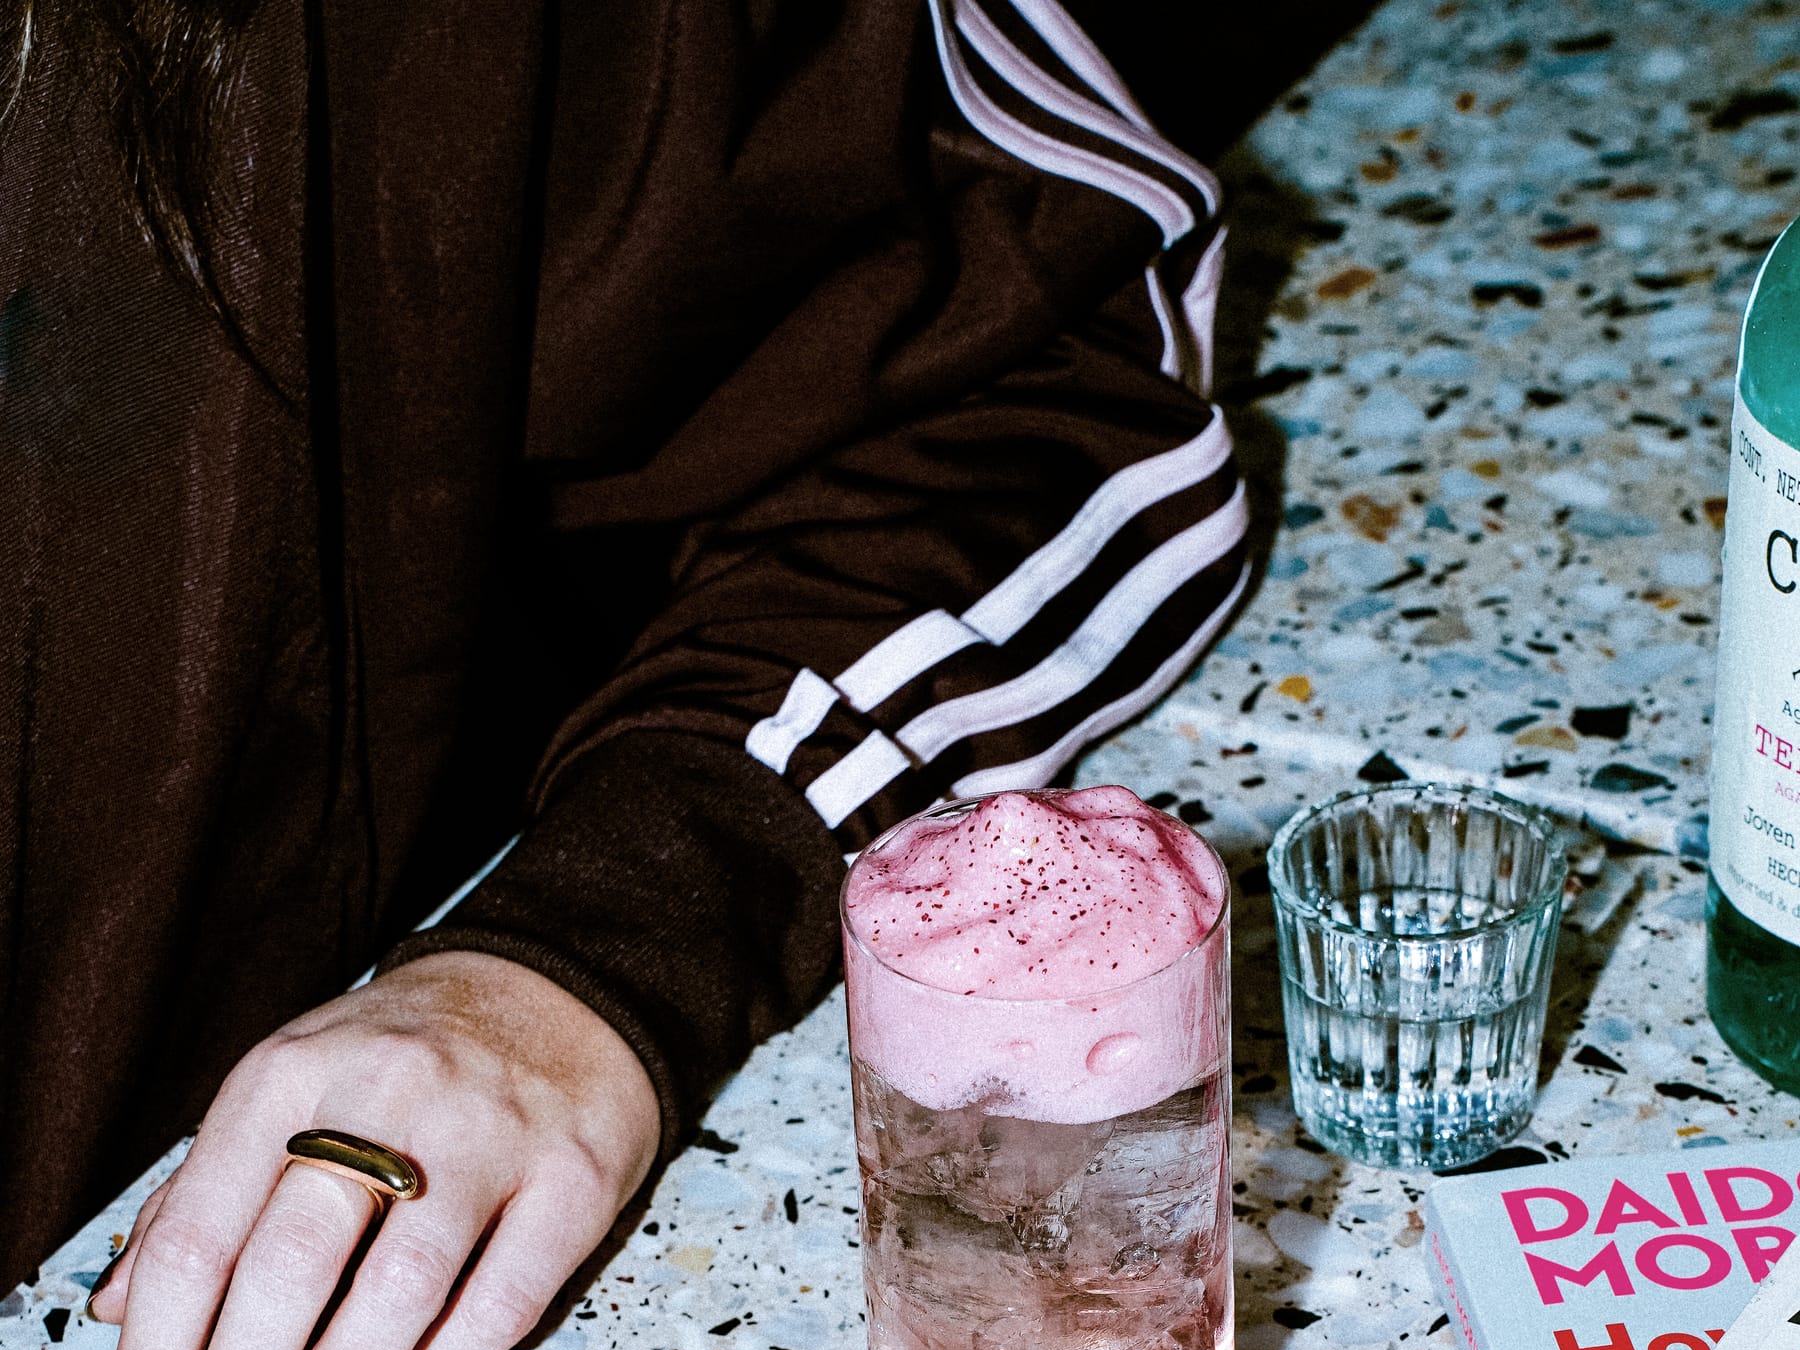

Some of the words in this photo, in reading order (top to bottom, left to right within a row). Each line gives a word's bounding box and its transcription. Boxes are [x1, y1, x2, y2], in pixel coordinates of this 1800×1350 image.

[1739, 430, 1766, 483] CONT.
[1766, 529, 1798, 594] C
[1755, 723, 1800, 774] TE
[1743, 805, 1795, 849] Joven
[1767, 856, 1800, 888] HEC
[1501, 1166, 1800, 1245] DAID
